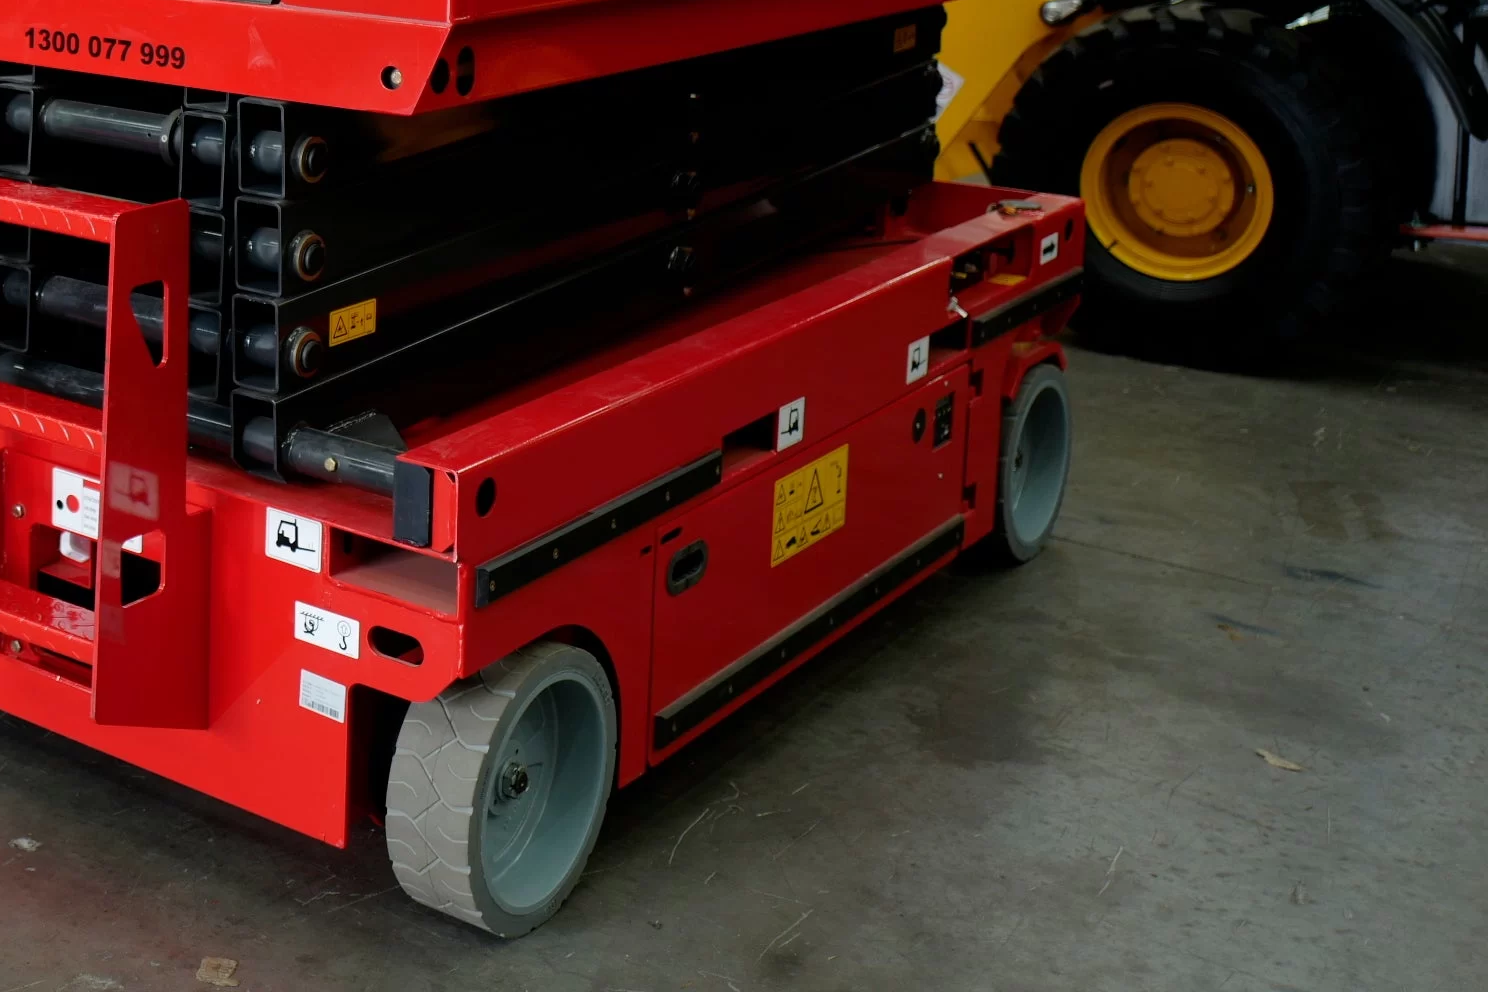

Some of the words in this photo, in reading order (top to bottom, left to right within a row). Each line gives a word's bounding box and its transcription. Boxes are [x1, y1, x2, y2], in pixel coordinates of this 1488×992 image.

[25, 27, 80, 55] 1300
[88, 36, 132, 62] 077
[140, 43, 186, 69] 999
